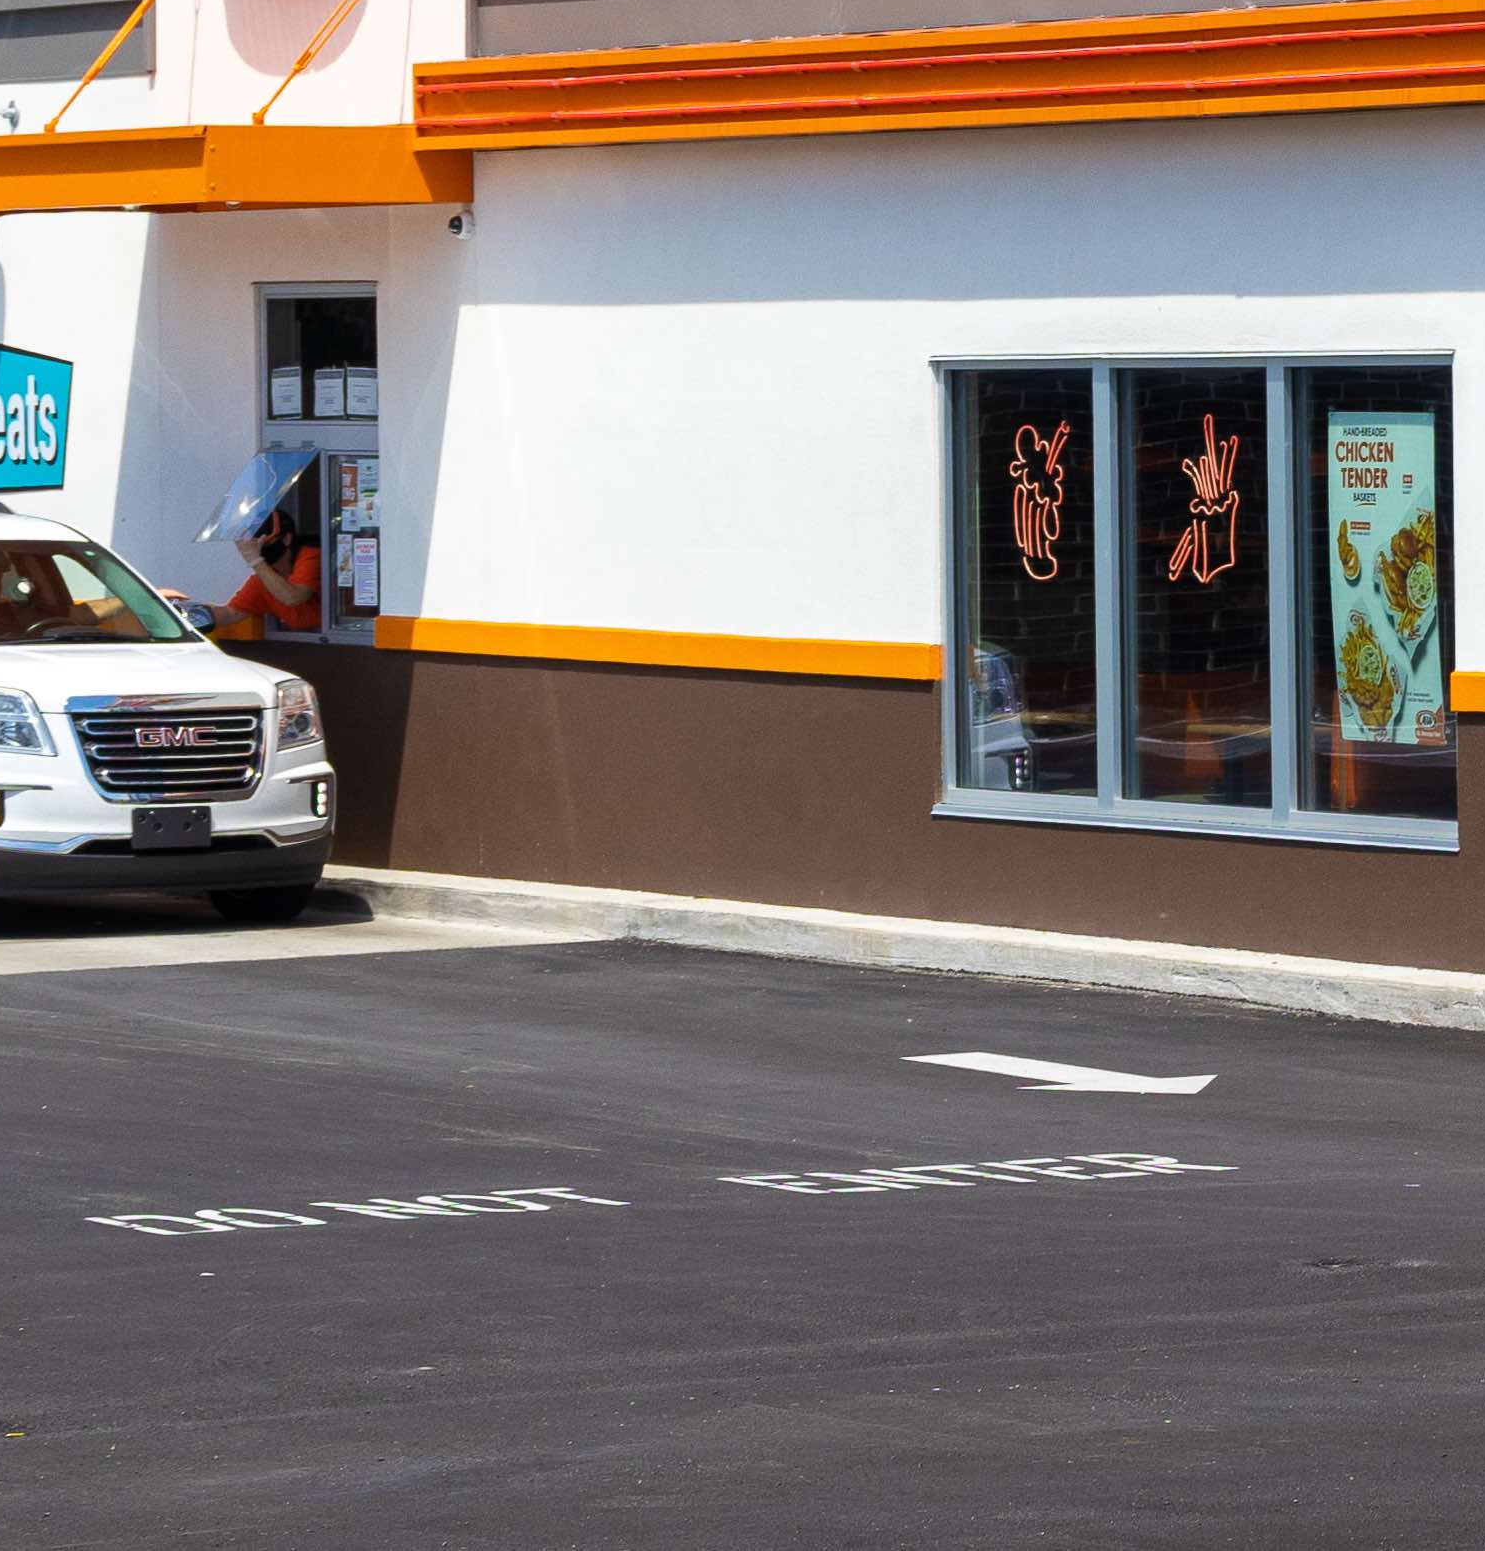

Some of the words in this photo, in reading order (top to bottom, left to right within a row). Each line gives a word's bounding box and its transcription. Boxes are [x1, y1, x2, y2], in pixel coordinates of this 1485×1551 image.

[1342, 427, 1388, 437] HAND-BREADED
[1335, 441, 1394, 463] CHICKEN
[1341, 468, 1388, 488] TENDER
[1353, 492, 1376, 502] BASKETS
[135, 726, 218, 748] GMC
[717, 1152, 1240, 1195] ENTER
[85, 1208, 327, 1236] DO
[309, 1187, 632, 1220] NOT
